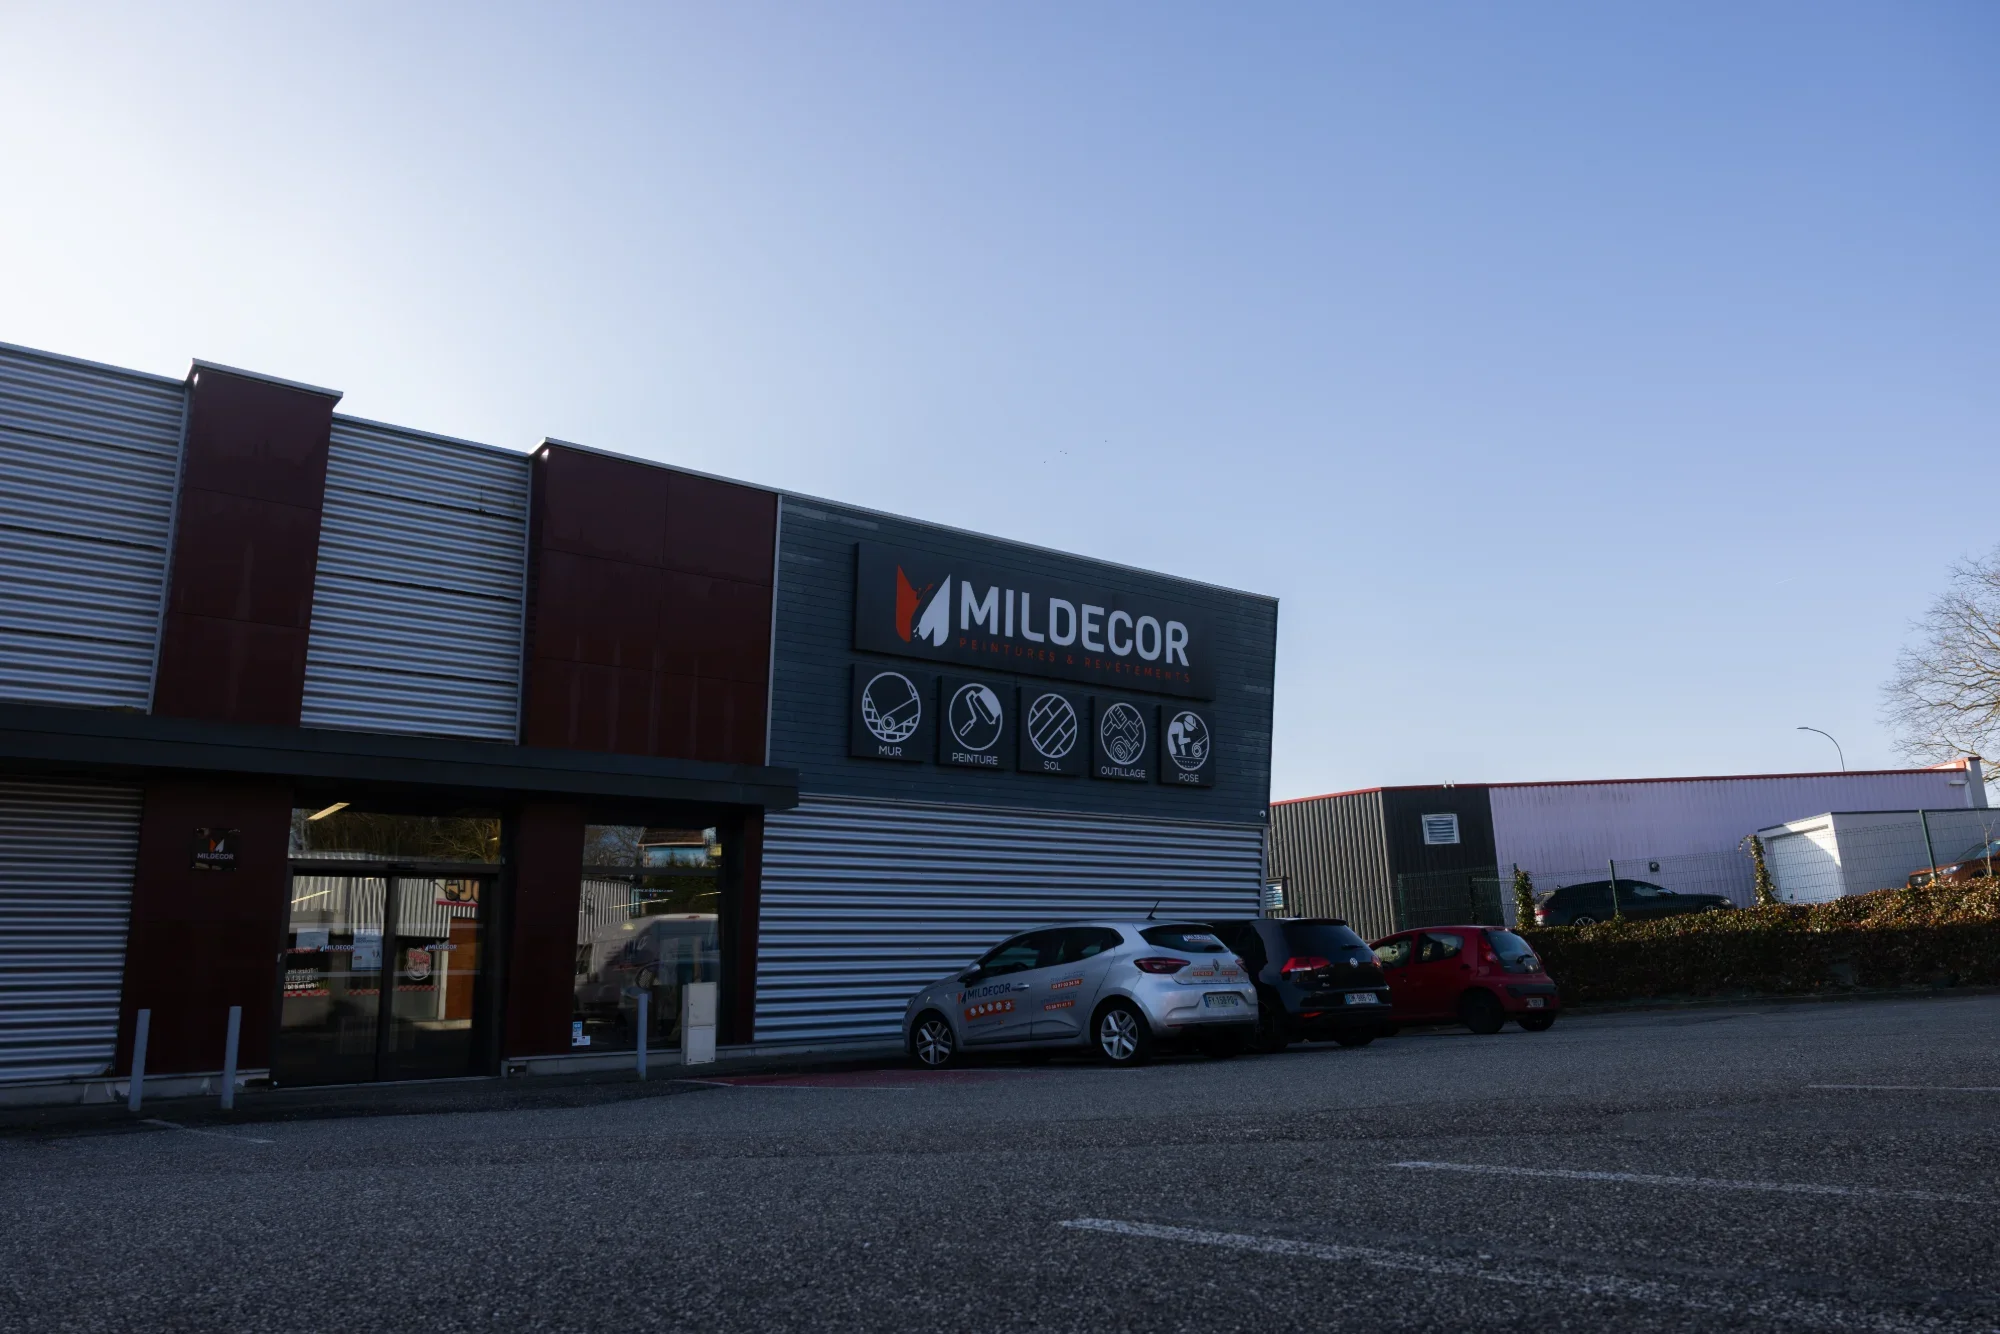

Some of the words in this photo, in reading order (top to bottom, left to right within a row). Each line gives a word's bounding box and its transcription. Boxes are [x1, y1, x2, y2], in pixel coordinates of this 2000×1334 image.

[960, 580, 1190, 667] MILDECOR
[959, 637, 1056, 663] PEINTURES
[1066, 655, 1074, 665] &
[878, 745, 902, 757] MUR
[952, 752, 998, 765] PEINTURE
[1043, 760, 1061, 771] SOL
[1101, 766, 1146, 779] OUTILLAGE
[1178, 773, 1199, 783] POSE
[967, 983, 1012, 1000] MILDECOR
